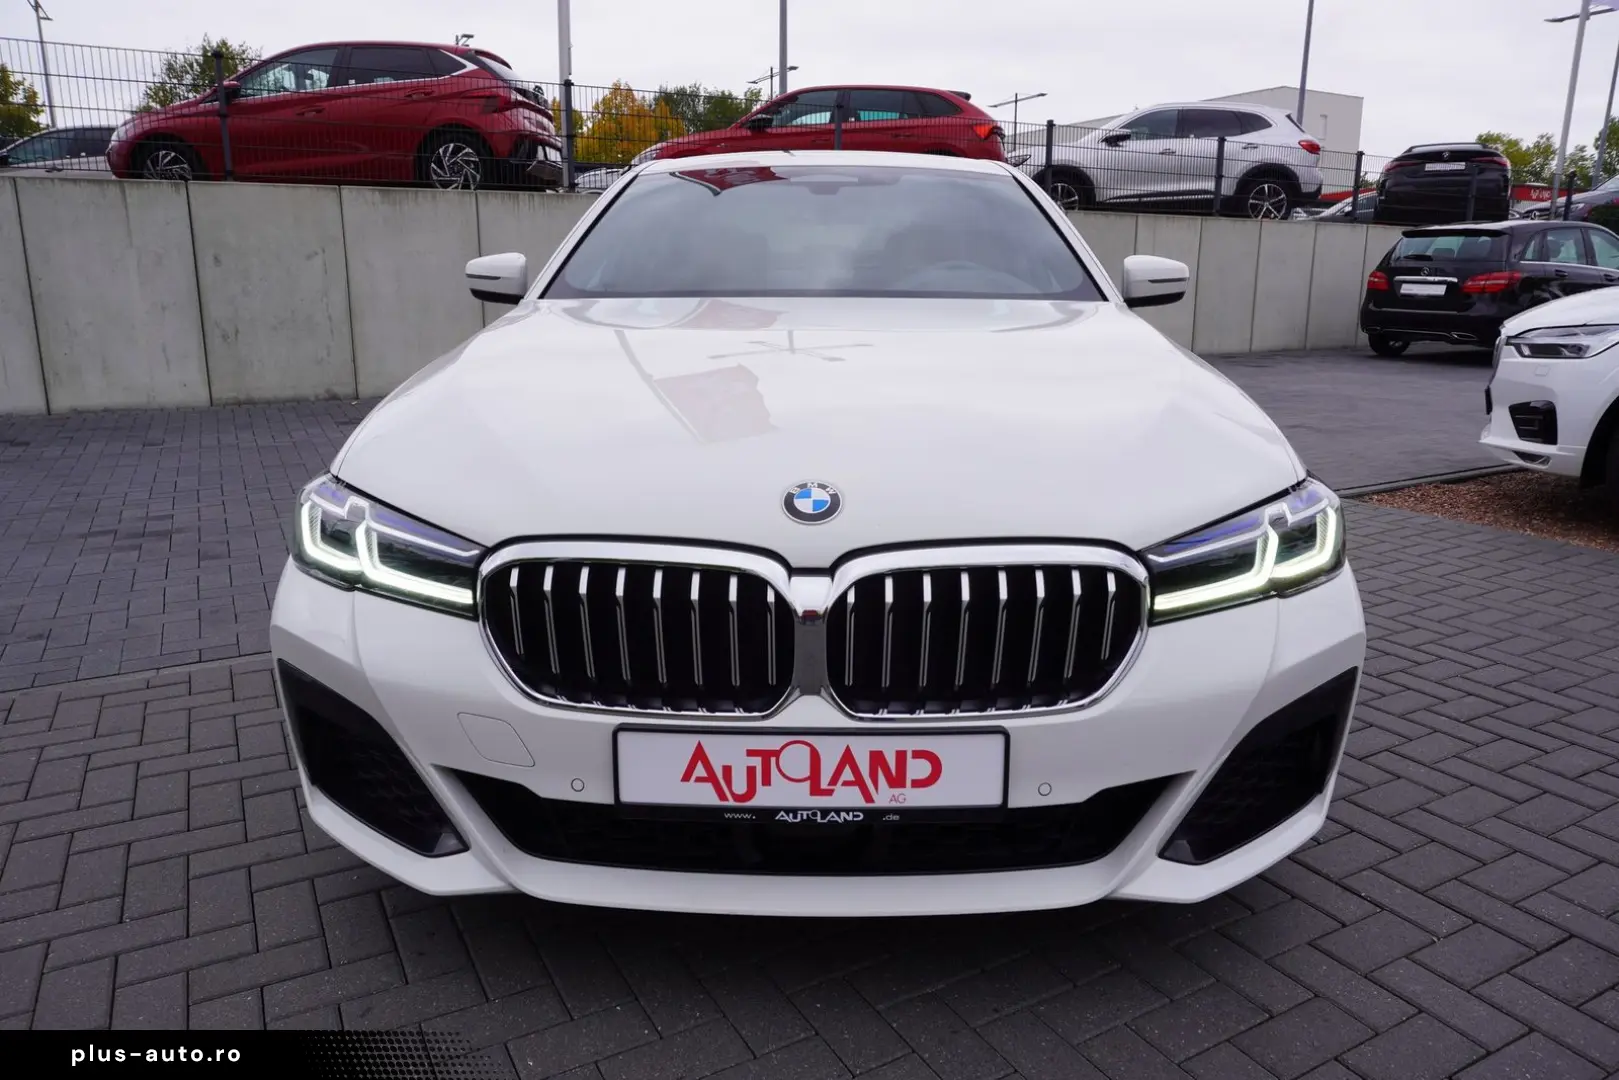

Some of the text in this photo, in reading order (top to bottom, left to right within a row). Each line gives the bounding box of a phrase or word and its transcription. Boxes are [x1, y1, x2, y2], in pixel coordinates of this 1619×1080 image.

[888, 792, 907, 804] AG
[723, 812, 756, 820] www.
[882, 812, 900, 821] .de
